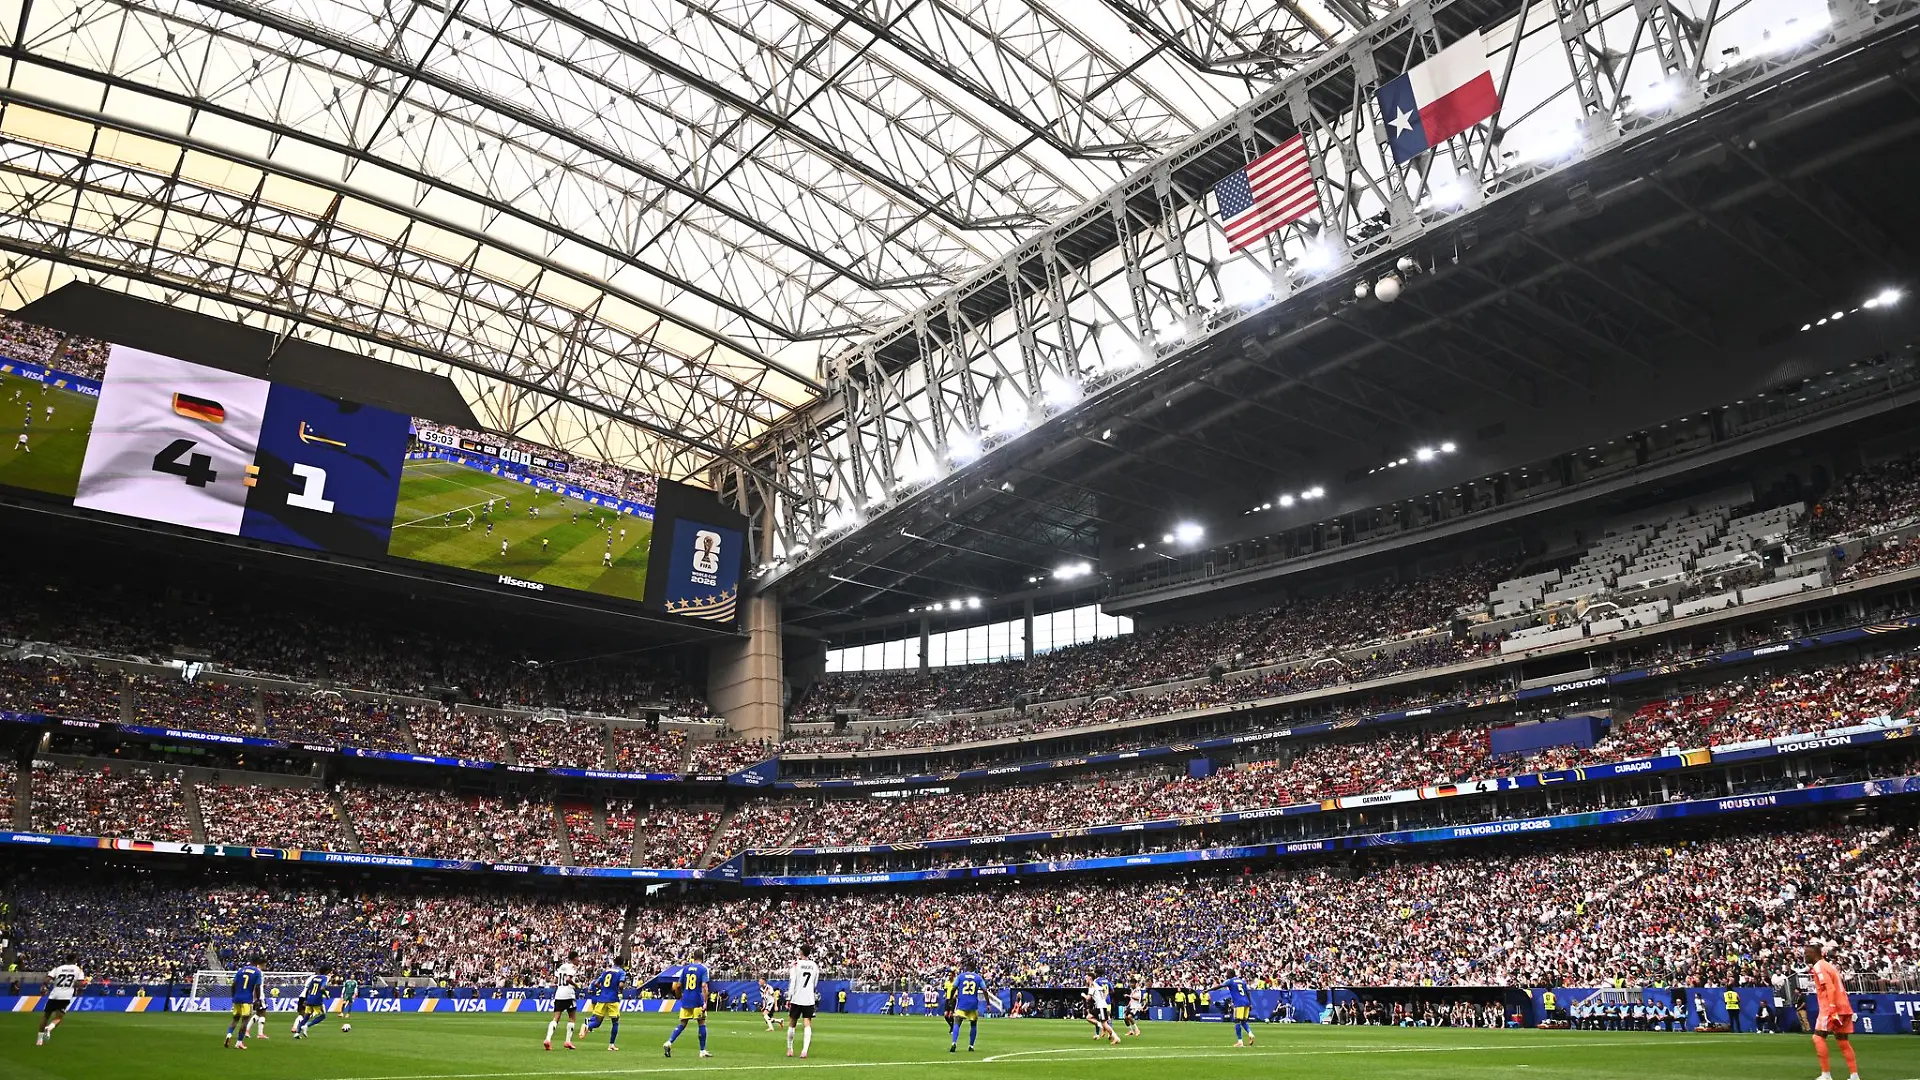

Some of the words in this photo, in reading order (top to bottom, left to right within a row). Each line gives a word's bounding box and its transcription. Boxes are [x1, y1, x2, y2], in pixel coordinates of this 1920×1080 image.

[22, 369, 44, 382] VISA
[75, 384, 100, 397] VISA
[425, 431, 453, 446] 59:03
[152, 438, 217, 488] 4
[286, 462, 335, 514] 1
[503, 471, 518, 480] VISA
[569, 490, 584, 500] VISA
[603, 501, 618, 510] VISA
[638, 510, 654, 520] VISA
[699, 562, 712, 570] FIFA
[497, 574, 544, 591] Hisense
[690, 575, 717, 587] 2026
[1552, 677, 1606, 693] HOUSTON
[62, 719, 100, 728] HOUSTON
[181, 731, 206, 740] WORLD
[1244, 734, 1262, 742] WORLD
[1273, 729, 1292, 738] 2026
[304, 744, 335, 753] HOUSTON
[1777, 734, 1851, 754] HOUSTON
[507, 765, 535, 773] HOUSTON
[988, 766, 1020, 775] HOUSTON
[1362, 794, 1392, 804] GERMANY
[1475, 781, 1488, 792] 4
[1508, 776, 1520, 790] 1
[1615, 762, 1652, 774] CURAÇAO
[1719, 794, 1776, 810] HOUSTON
[1239, 809, 1284, 820] HOUSTON
[1454, 828, 1471, 837] FIFA
[1472, 824, 1501, 835] WORLD
[1502, 822, 1519, 832] CUP
[1520, 820, 1551, 831] 2026
[970, 836, 1006, 845] HOUSTON
[1287, 841, 1322, 852] HOUSTON
[180, 843, 193, 854] 4
[214, 845, 226, 856] 1
[343, 855, 371, 863] WORLD
[387, 858, 413, 866] 2026
[494, 864, 528, 873] HOUSTON
[979, 867, 1007, 875] HOUSTON
[861, 874, 872, 882] CUP
[56, 973, 75, 987] 23
[243, 975, 249, 989] 7
[558, 973, 568, 986] 10
[603, 973, 612, 987] 8
[685, 973, 697, 990] 18
[802, 971, 811, 988] 7
[962, 980, 976, 995] 23
[1237, 983, 1244, 996] 5
[505, 991, 527, 999] FIFA
[169, 997, 211, 1012] VISA
[270, 997, 300, 1012] VIS
[363, 998, 400, 1012] VISA
[452, 998, 487, 1012] VISA
[533, 999, 555, 1012] VIS
